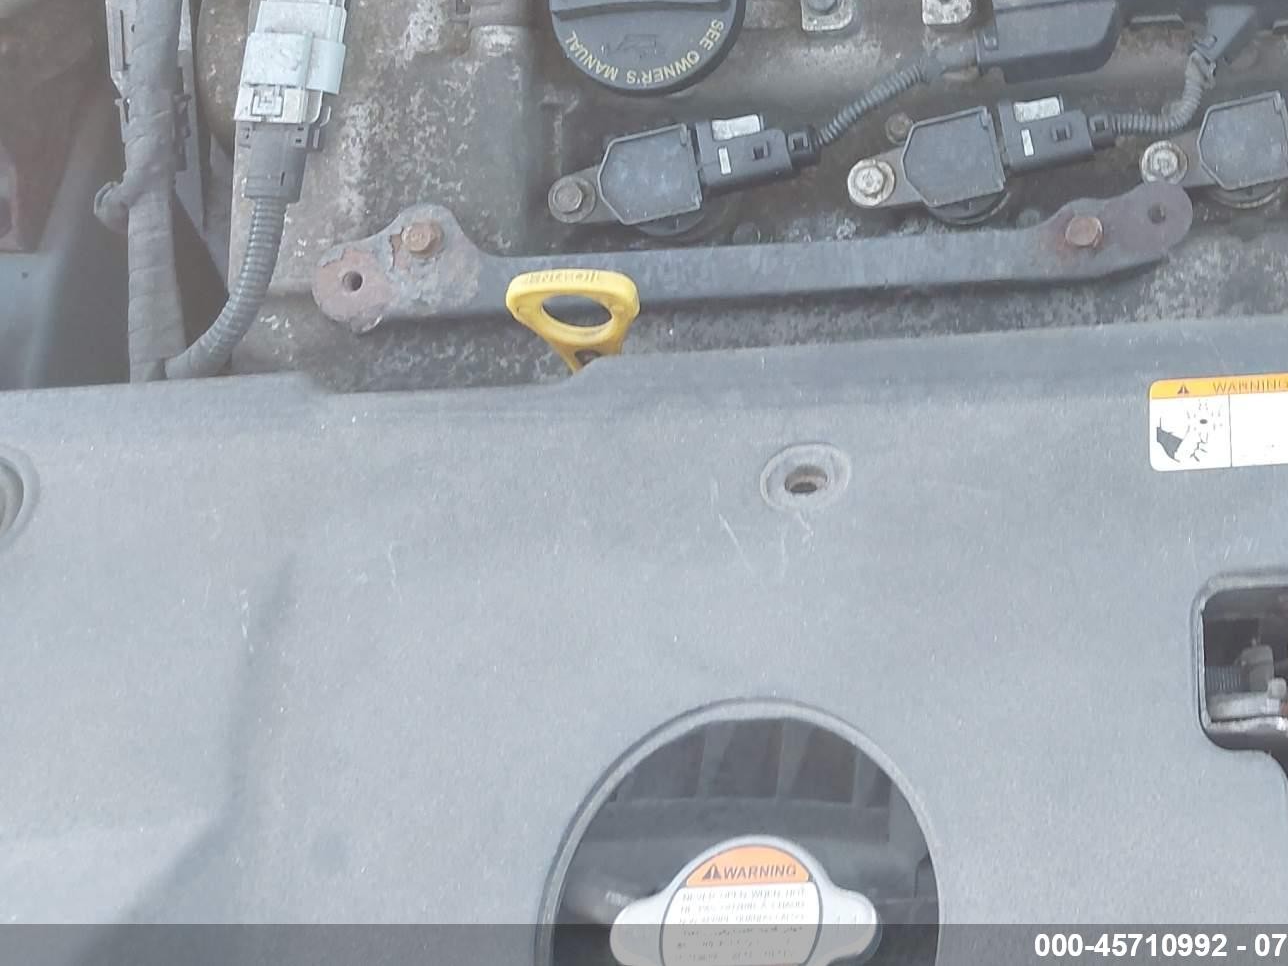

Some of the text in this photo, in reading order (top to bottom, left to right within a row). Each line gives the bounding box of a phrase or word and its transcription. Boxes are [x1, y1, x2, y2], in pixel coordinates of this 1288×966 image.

[565, 18, 725, 87] SEE OWNER'S MANUAL
[1212, 379, 1288, 395] WARNING
[723, 864, 797, 880] WARNING
